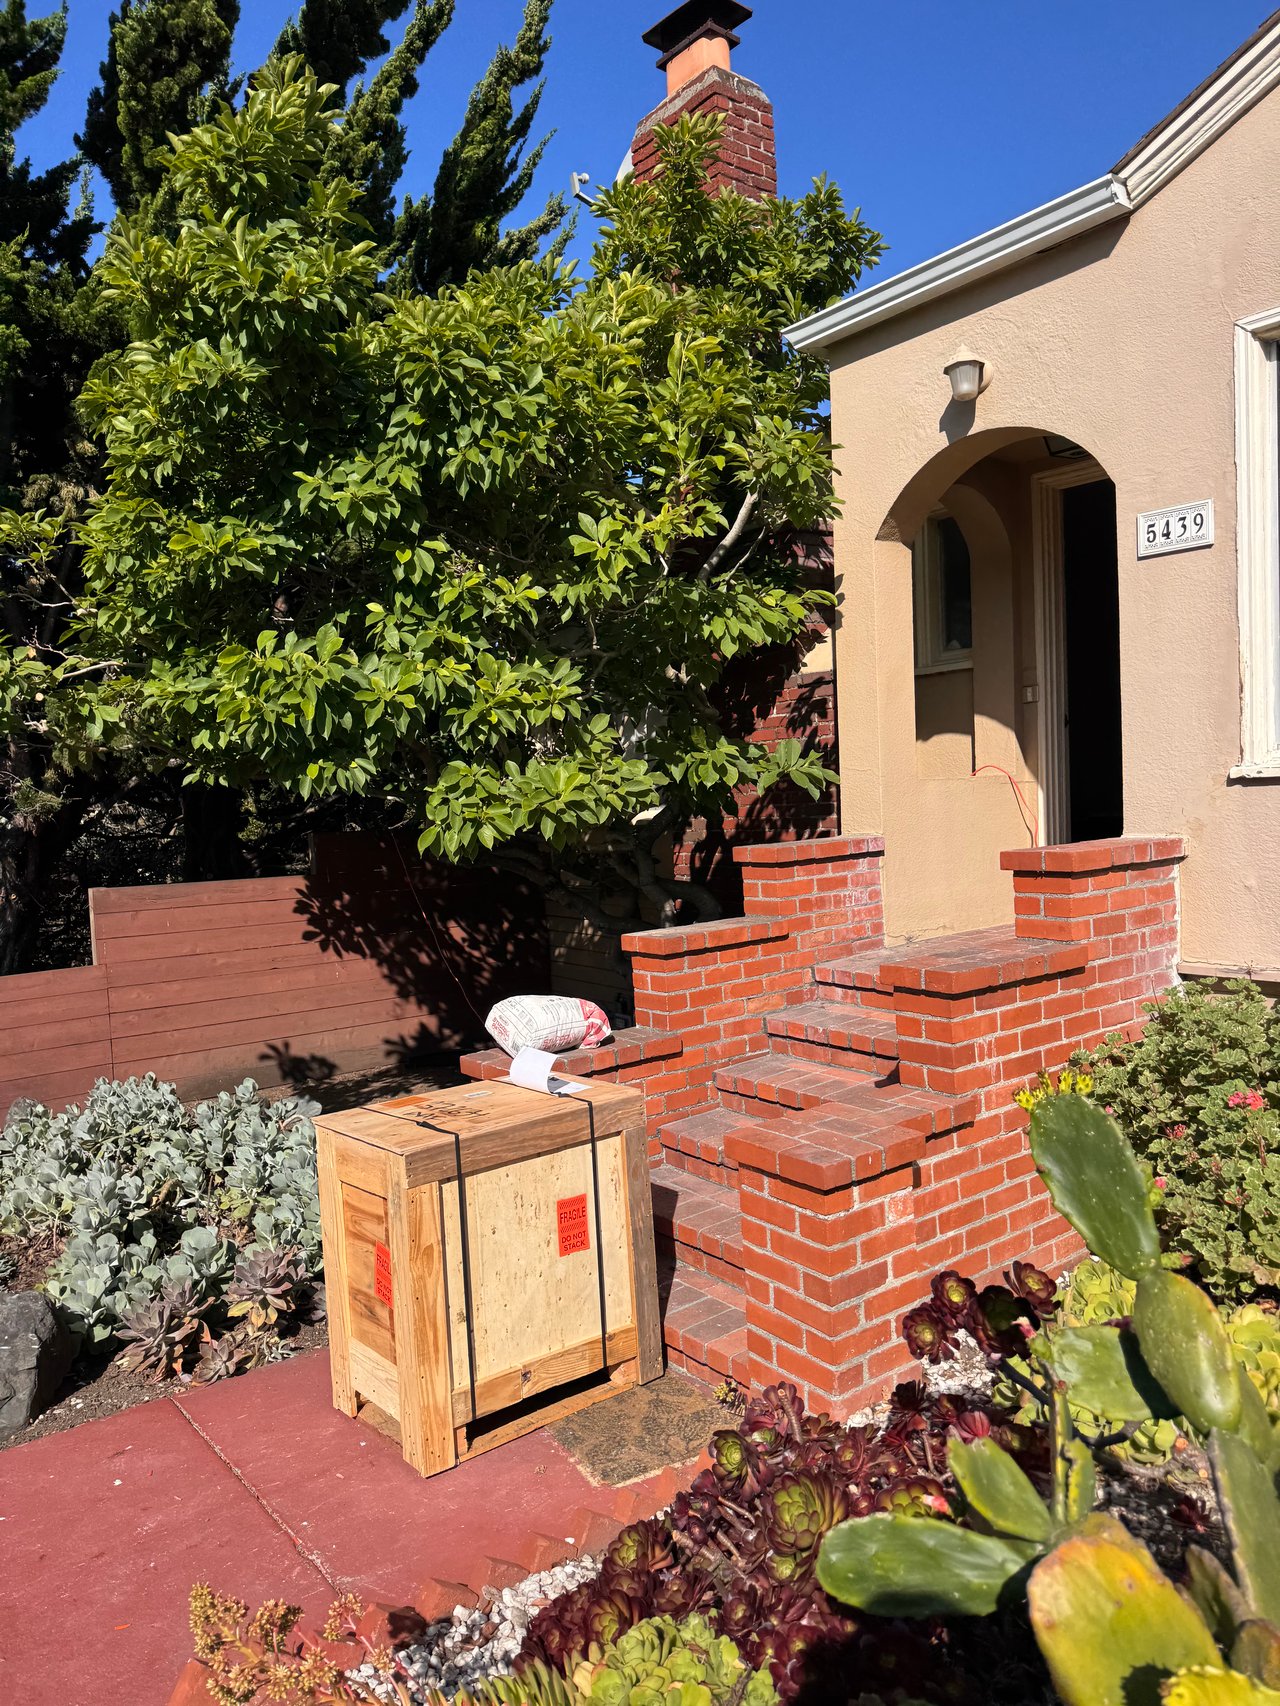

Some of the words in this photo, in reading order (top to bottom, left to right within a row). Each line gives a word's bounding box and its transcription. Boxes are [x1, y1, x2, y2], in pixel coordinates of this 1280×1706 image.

[1146, 512, 1204, 543] 5439
[559, 1206, 586, 1224] FRAGILE
[561, 1234, 572, 1244] DO
[572, 1230, 586, 1240] NOT
[563, 1239, 586, 1252] STACK
[376, 1253, 392, 1276] FRAGIL
